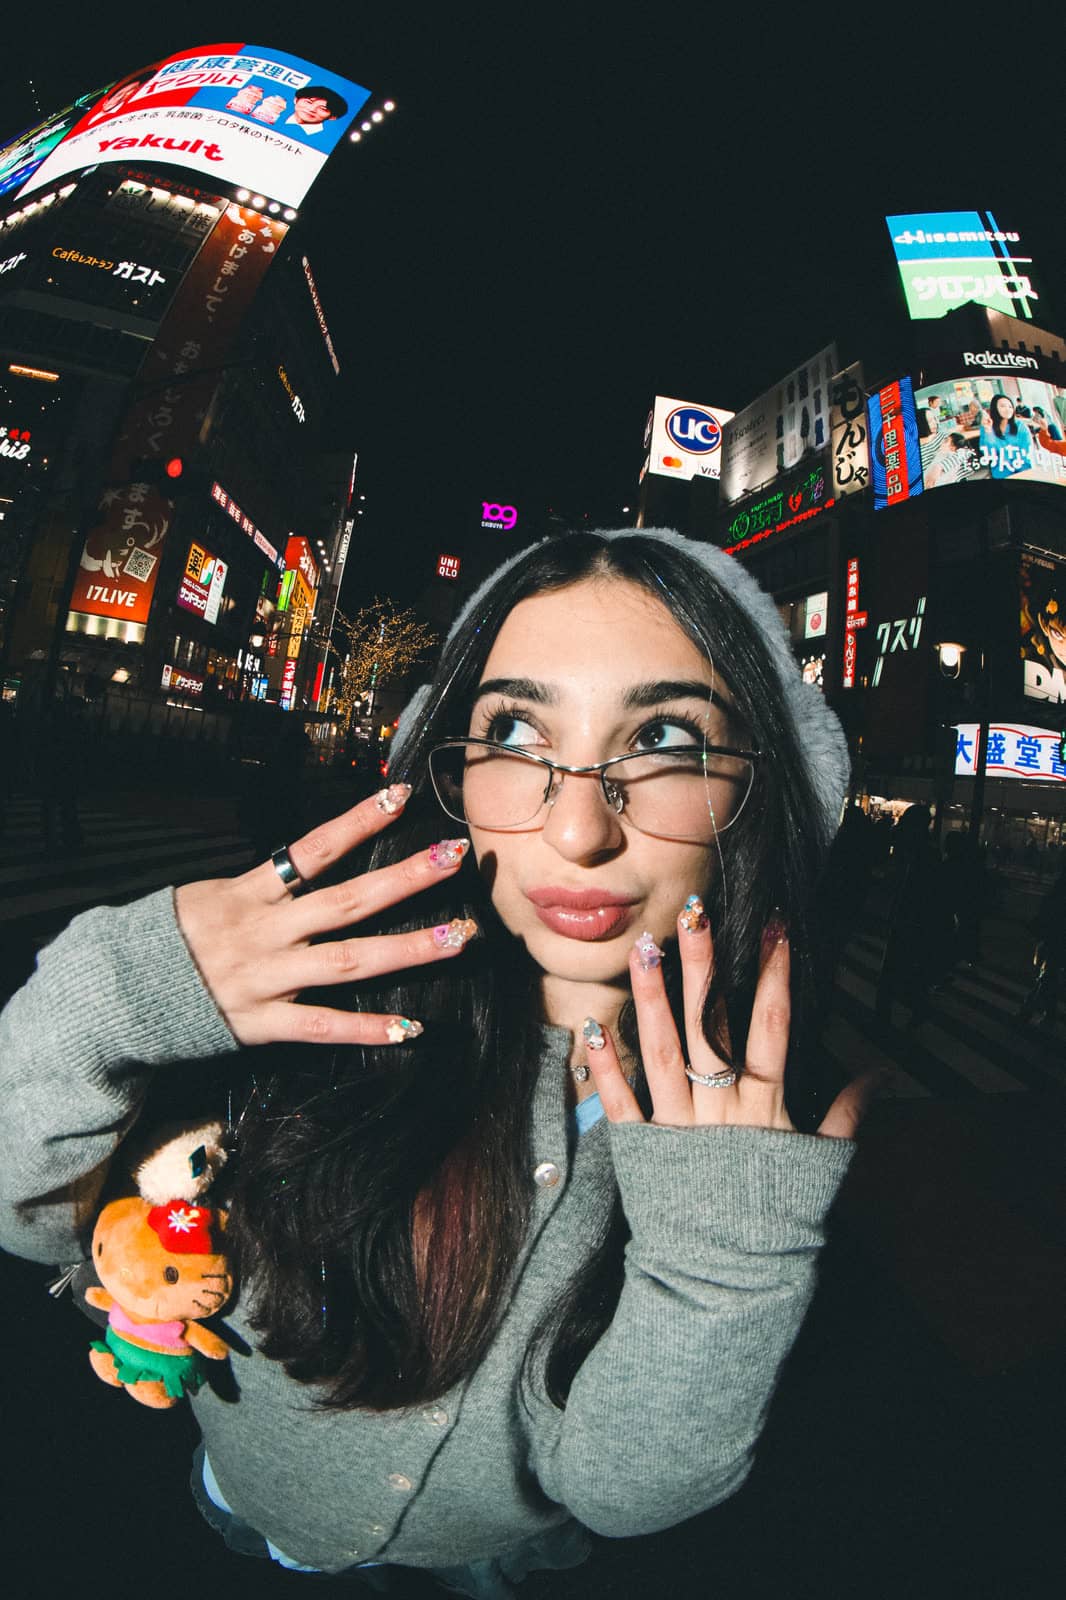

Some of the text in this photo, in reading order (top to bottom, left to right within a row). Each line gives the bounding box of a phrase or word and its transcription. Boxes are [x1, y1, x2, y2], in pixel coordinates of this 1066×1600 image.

[145, 71, 244, 94] ヤクルト
[159, 57, 305, 86] 健康管理に
[97, 133, 225, 162] Yakult
[207, 115, 303, 156] シロタ株のヤクルト
[895, 230, 1021, 245] Hisamitsu
[0, 252, 27, 274] スト
[112, 260, 166, 287] ガスト
[911, 275, 1040, 301] サロンパス
[963, 350, 1039, 370] Rakuten
[673, 415, 719, 445] UC
[834, 374, 868, 486] もんじゃ
[881, 387, 903, 497] 三千里薬品
[701, 465, 720, 477] VIS
[481, 501, 518, 530] 109
[439, 566, 458, 578] QLO
[440, 556, 458, 569] UNI
[85, 583, 139, 608] 17LIVE
